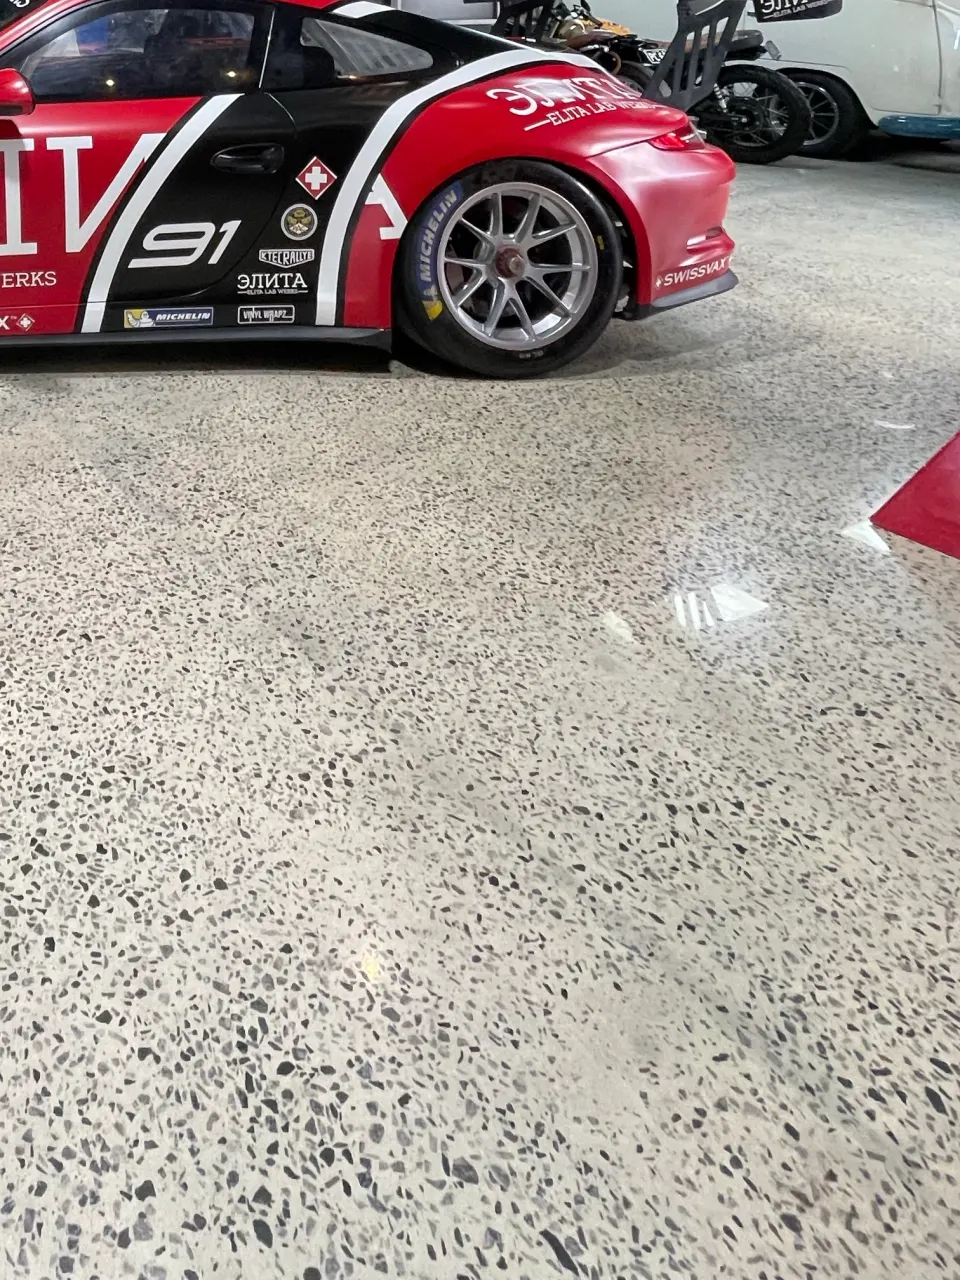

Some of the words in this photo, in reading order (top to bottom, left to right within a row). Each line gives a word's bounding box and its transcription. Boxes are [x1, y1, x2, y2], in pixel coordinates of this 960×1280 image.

[546, 105, 591, 126] ELITA
[586, 100, 617, 114] LAB
[127, 219, 242, 269] 91
[420, 189, 458, 282] MICHELIN
[236, 272, 308, 289] ЭЛИТА
[663, 257, 726, 286] SWISSVAX
[155, 312, 211, 321] MICHELIN
[243, 308, 262, 321] VINYL
